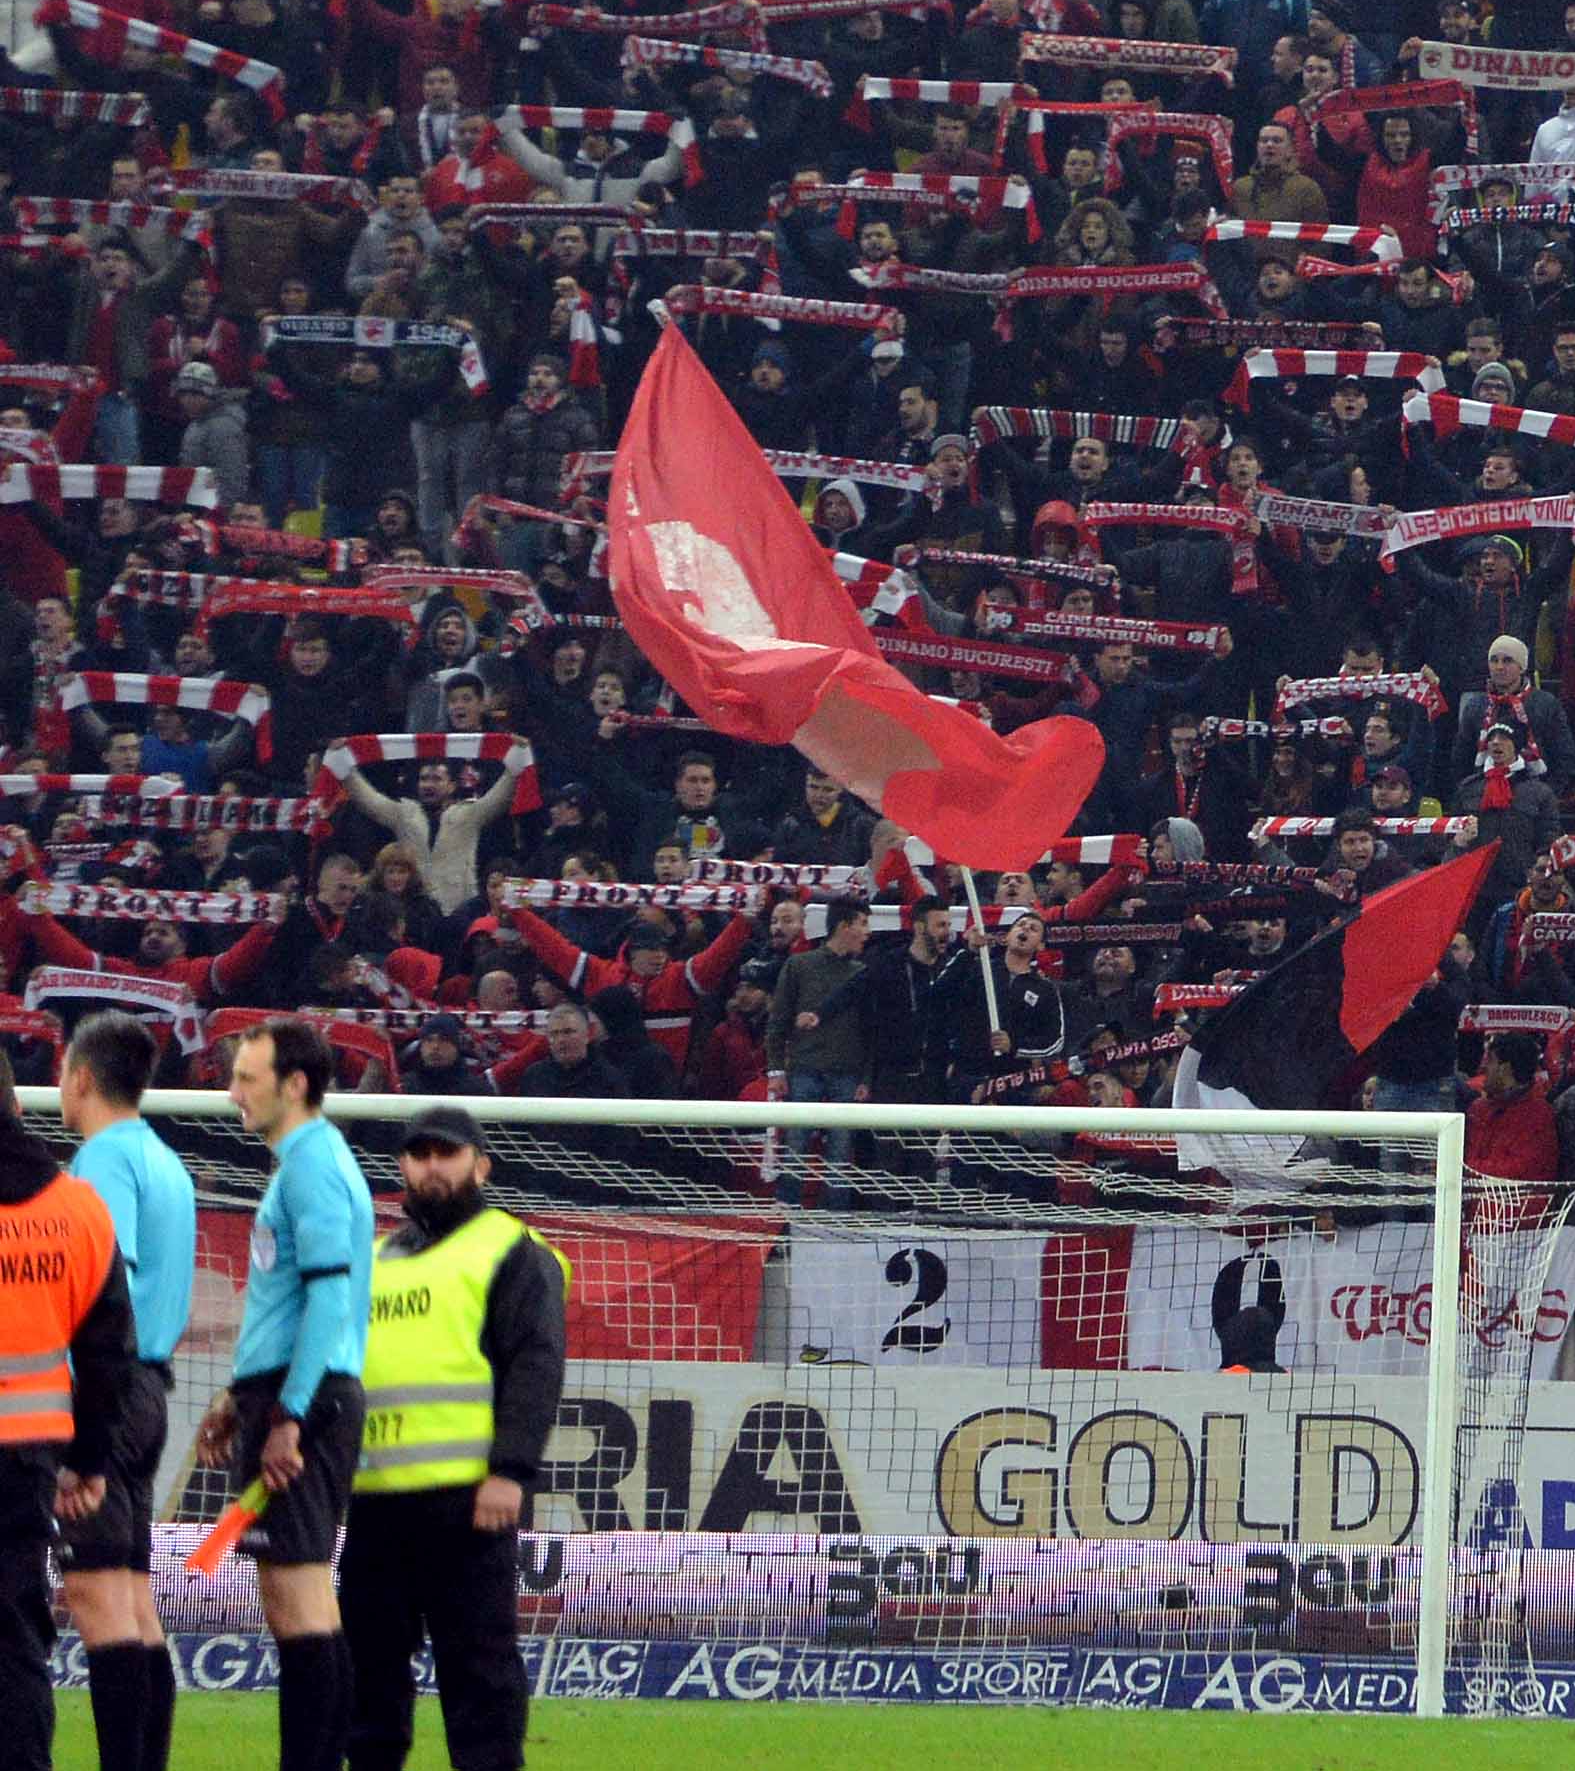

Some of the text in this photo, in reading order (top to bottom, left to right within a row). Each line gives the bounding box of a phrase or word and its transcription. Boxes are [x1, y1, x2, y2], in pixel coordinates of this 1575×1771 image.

[1451, 48, 1575, 78] DINAMO
[1017, 273, 1200, 291] DINAMO BUCURESTI
[749, 293, 882, 321] DINAMO
[1086, 502, 1145, 521] NAMO
[1269, 499, 1356, 522] DINAMO
[1024, 623, 1176, 646] IDOLI PENTRU NOI
[699, 862, 830, 885] FRONT
[69, 887, 273, 923] FRONT 48
[554, 884, 748, 912] FRONT 48
[880, 1247, 952, 1354] 2
[934, 1406, 1422, 1546] GOLD
[557, 1638, 644, 1682] AG
[664, 1644, 1070, 1701] AG MEDIA SPORT
[1086, 1656, 1163, 1695] AG
[1193, 1656, 1306, 1713] AG
[1312, 1671, 1445, 1711] MEDI
